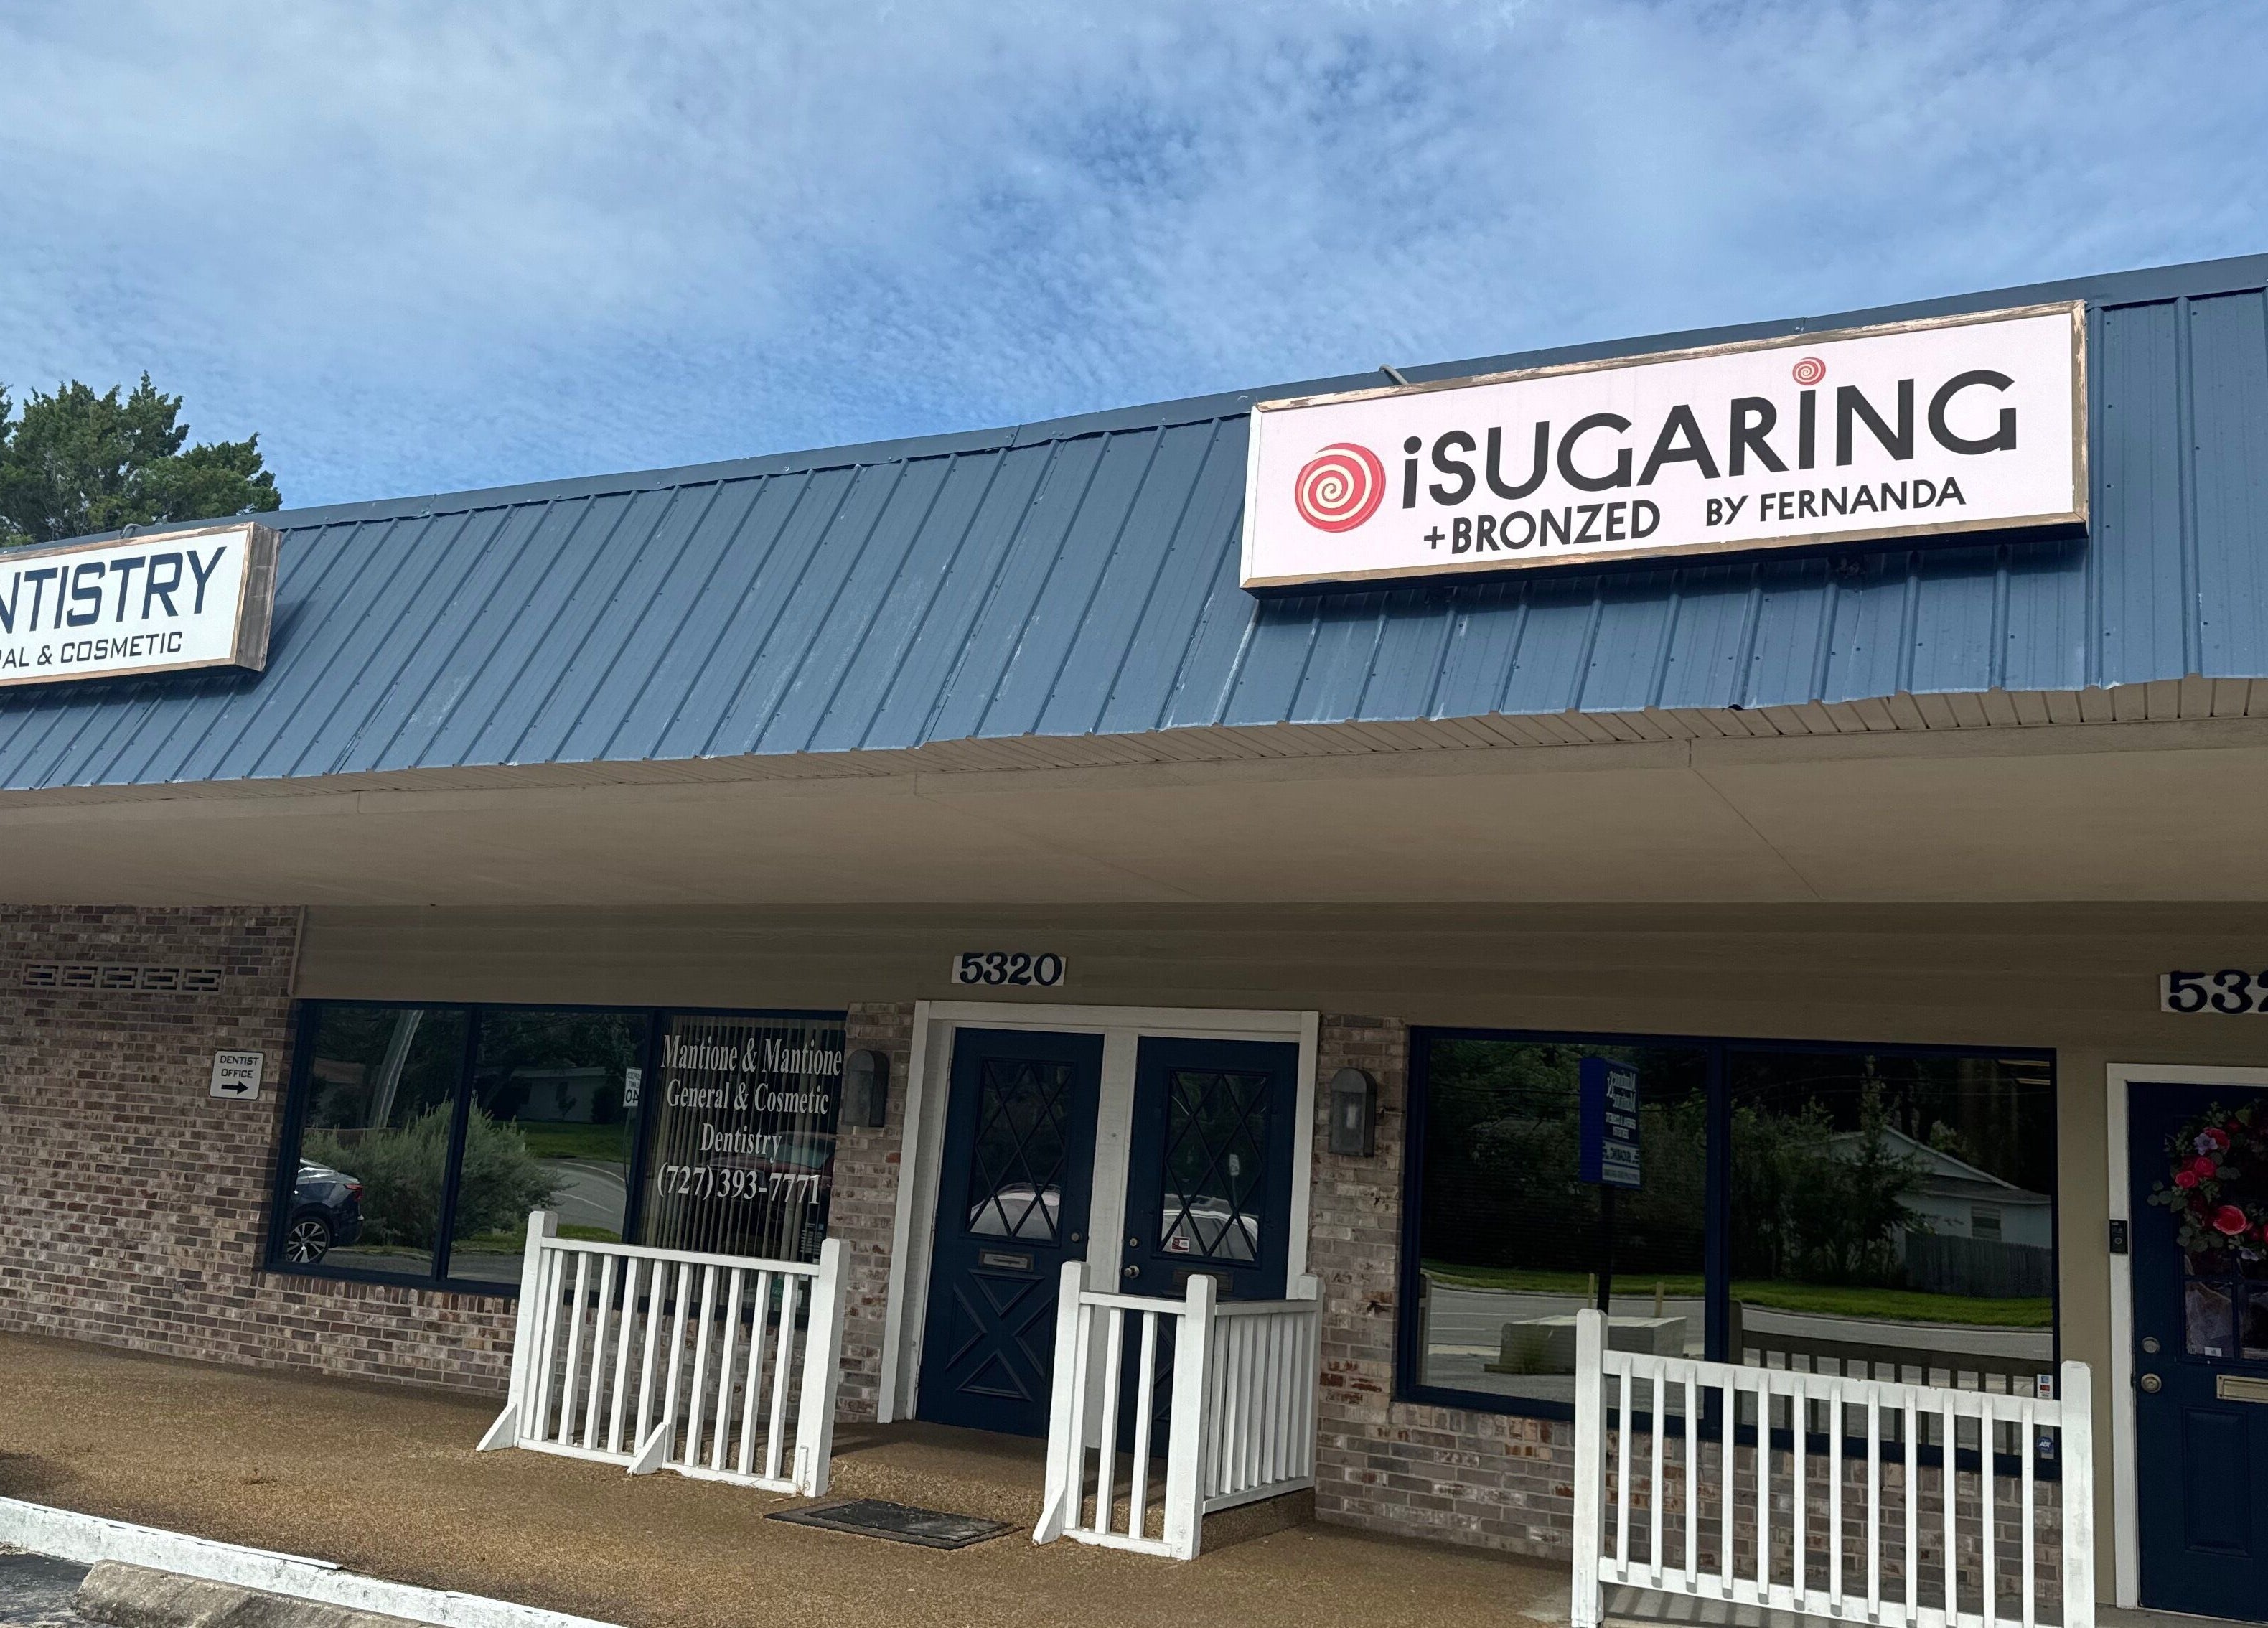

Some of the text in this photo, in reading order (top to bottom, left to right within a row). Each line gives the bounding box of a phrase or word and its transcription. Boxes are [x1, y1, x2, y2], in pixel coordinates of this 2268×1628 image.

[1402, 357, 2017, 510] iSUGARING
[1706, 495, 1748, 527] BY
[1760, 477, 1967, 522] FERNANDA
[0, 631, 183, 669] AL & COSMETIC
[960, 951, 1062, 987] 5320
[2168, 970, 2268, 1014] 53
[220, 1055, 260, 1066] DENTIST
[221, 1068, 254, 1079] OFFICE
[660, 1034, 843, 1076] Mantione & Mantione
[666, 1078, 829, 1115] General & Cosmetic
[700, 1123, 782, 1165] Dentistry
[657, 1162, 822, 1205] (727) 393-7771
